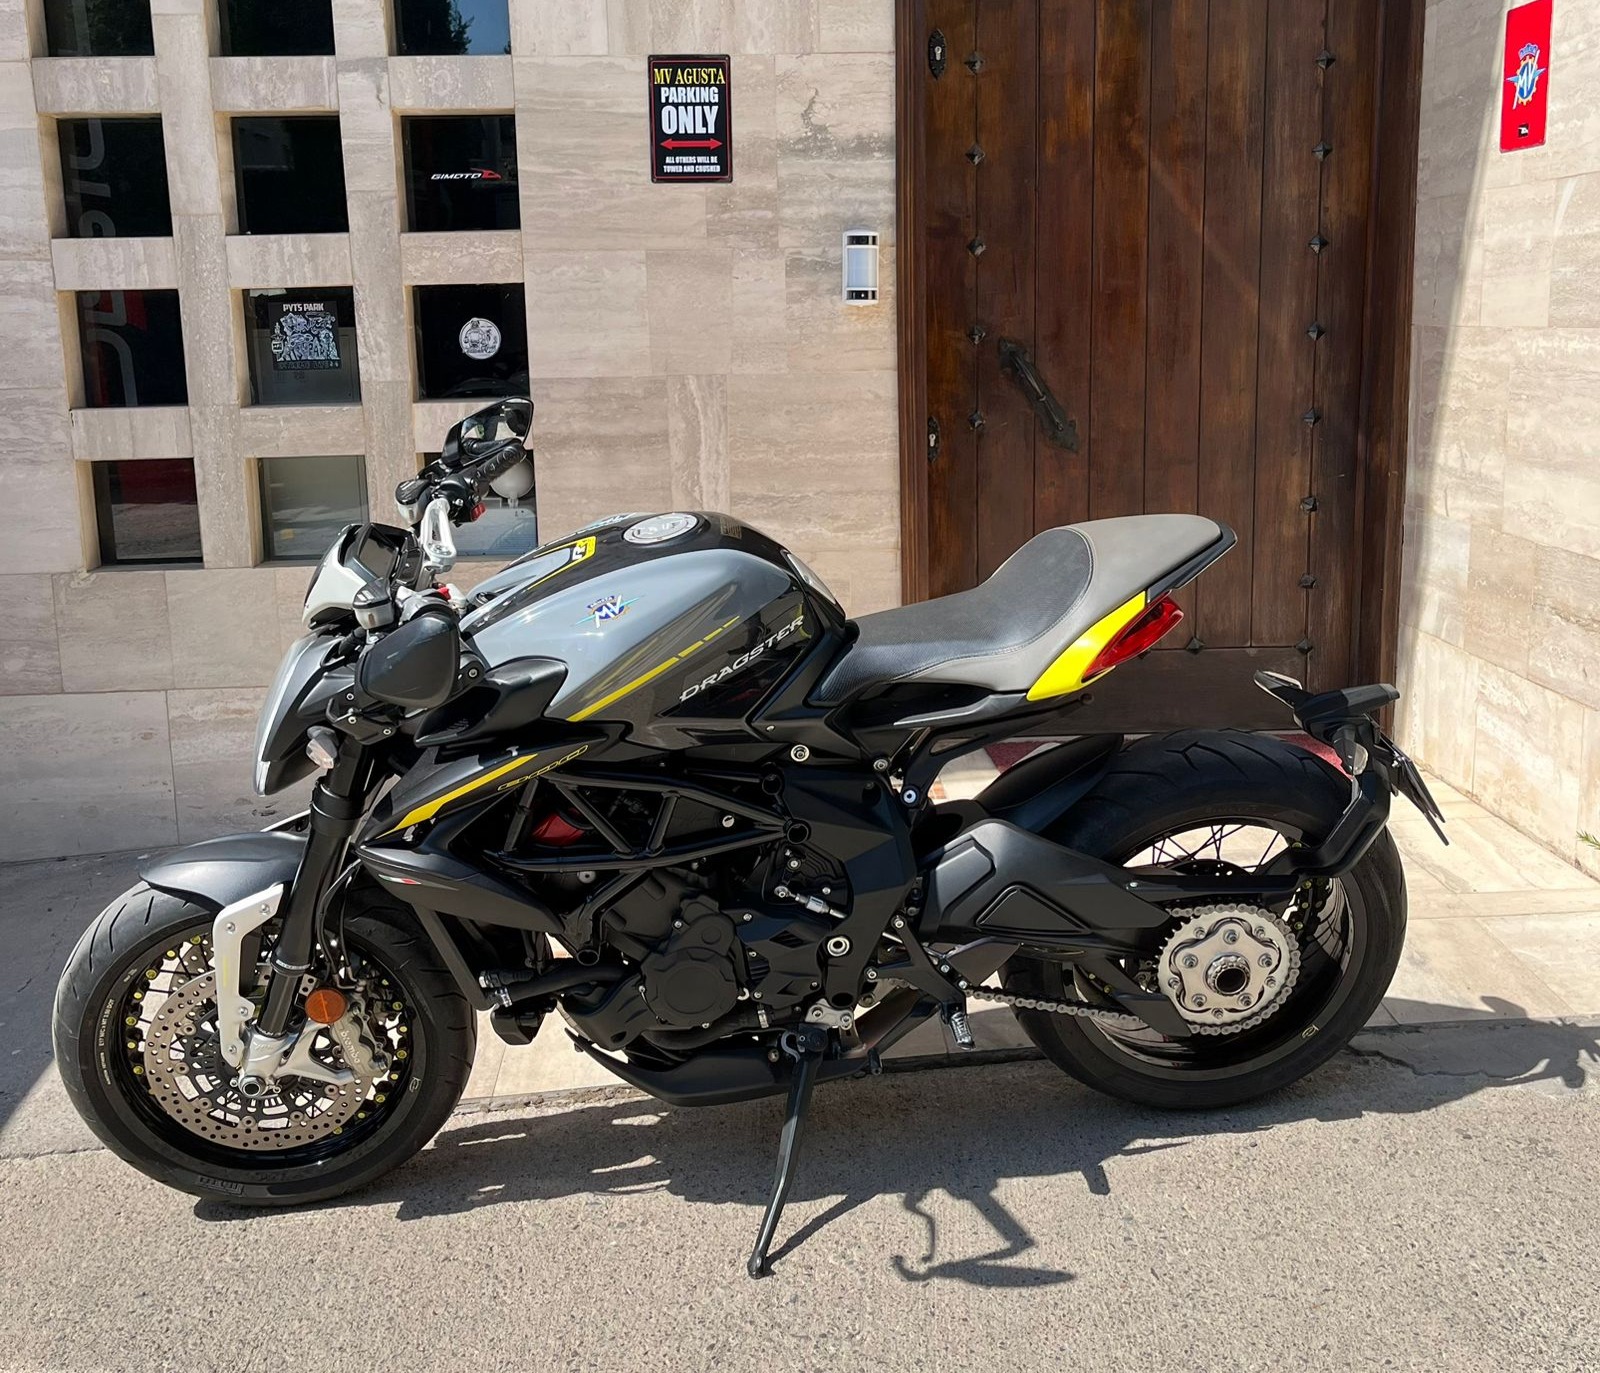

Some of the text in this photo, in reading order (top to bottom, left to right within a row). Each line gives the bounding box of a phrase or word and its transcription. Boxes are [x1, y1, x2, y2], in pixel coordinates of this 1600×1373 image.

[653, 68, 726, 85] MV AGUSTA
[660, 86, 719, 103] PARKING
[661, 105, 719, 135] ONLY
[665, 156, 718, 164] ALL OTHERS WILL BE
[663, 165, 721, 173] TOWED AND CRUSHED
[303, 302, 325, 312] PARK
[679, 615, 804, 702] DRAGSTER
[340, 1030, 361, 1064] brembo
